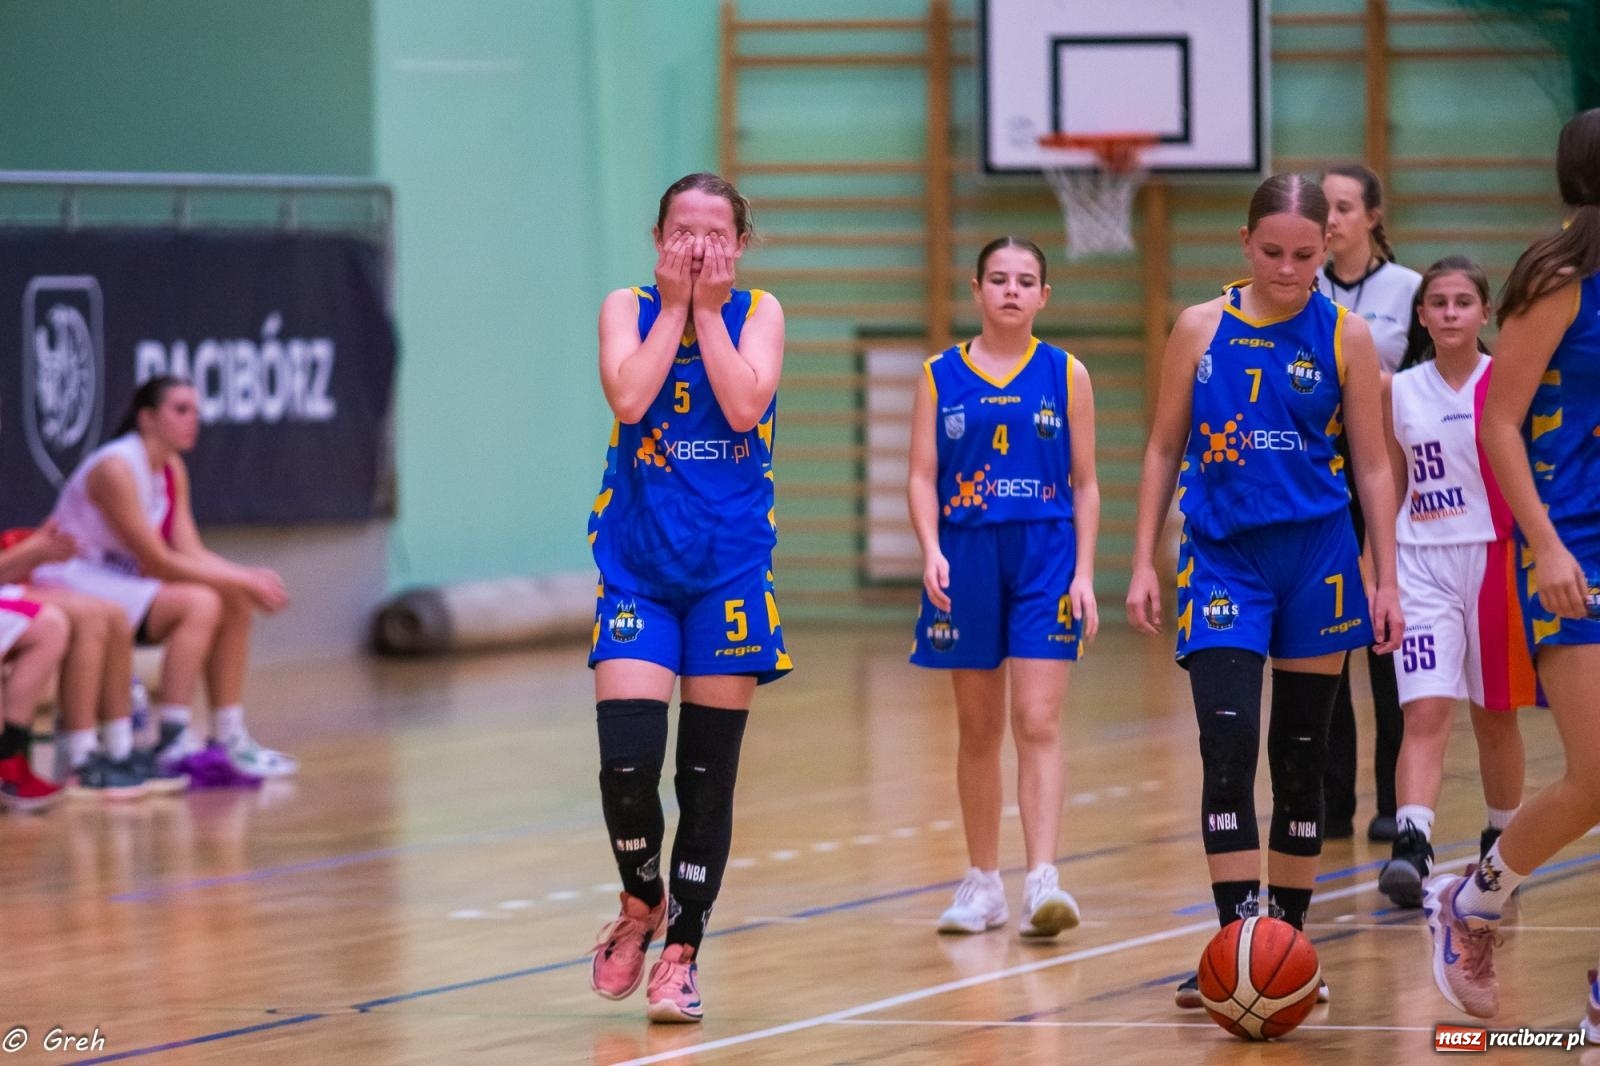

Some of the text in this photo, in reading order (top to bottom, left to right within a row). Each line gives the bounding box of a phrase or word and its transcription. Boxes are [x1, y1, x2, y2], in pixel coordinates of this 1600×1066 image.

[1229, 338, 1276, 349] regio
[1244, 368, 1263, 403] 7
[1287, 364, 1322, 382] RMKS
[673, 381, 691, 414] 5
[663, 437, 750, 464] XBEST.pl
[992, 424, 1010, 456] 4
[1411, 439, 1446, 484] 55
[985, 478, 1057, 503] XBEST.pl
[1409, 486, 1466, 516] MINI
[1324, 573, 1344, 619] 7
[724, 599, 748, 642] 5
[1057, 594, 1072, 631] 4
[1203, 604, 1240, 617] RMKS
[608, 617, 643, 630] RMKS
[1319, 617, 1363, 637] regio
[714, 644, 763, 657] regio
[1402, 634, 1437, 673] 55
[1216, 812, 1238, 831] NBA
[1297, 821, 1317, 838] NBA
[625, 837, 647, 851] NBA
[685, 864, 706, 883] NBA
